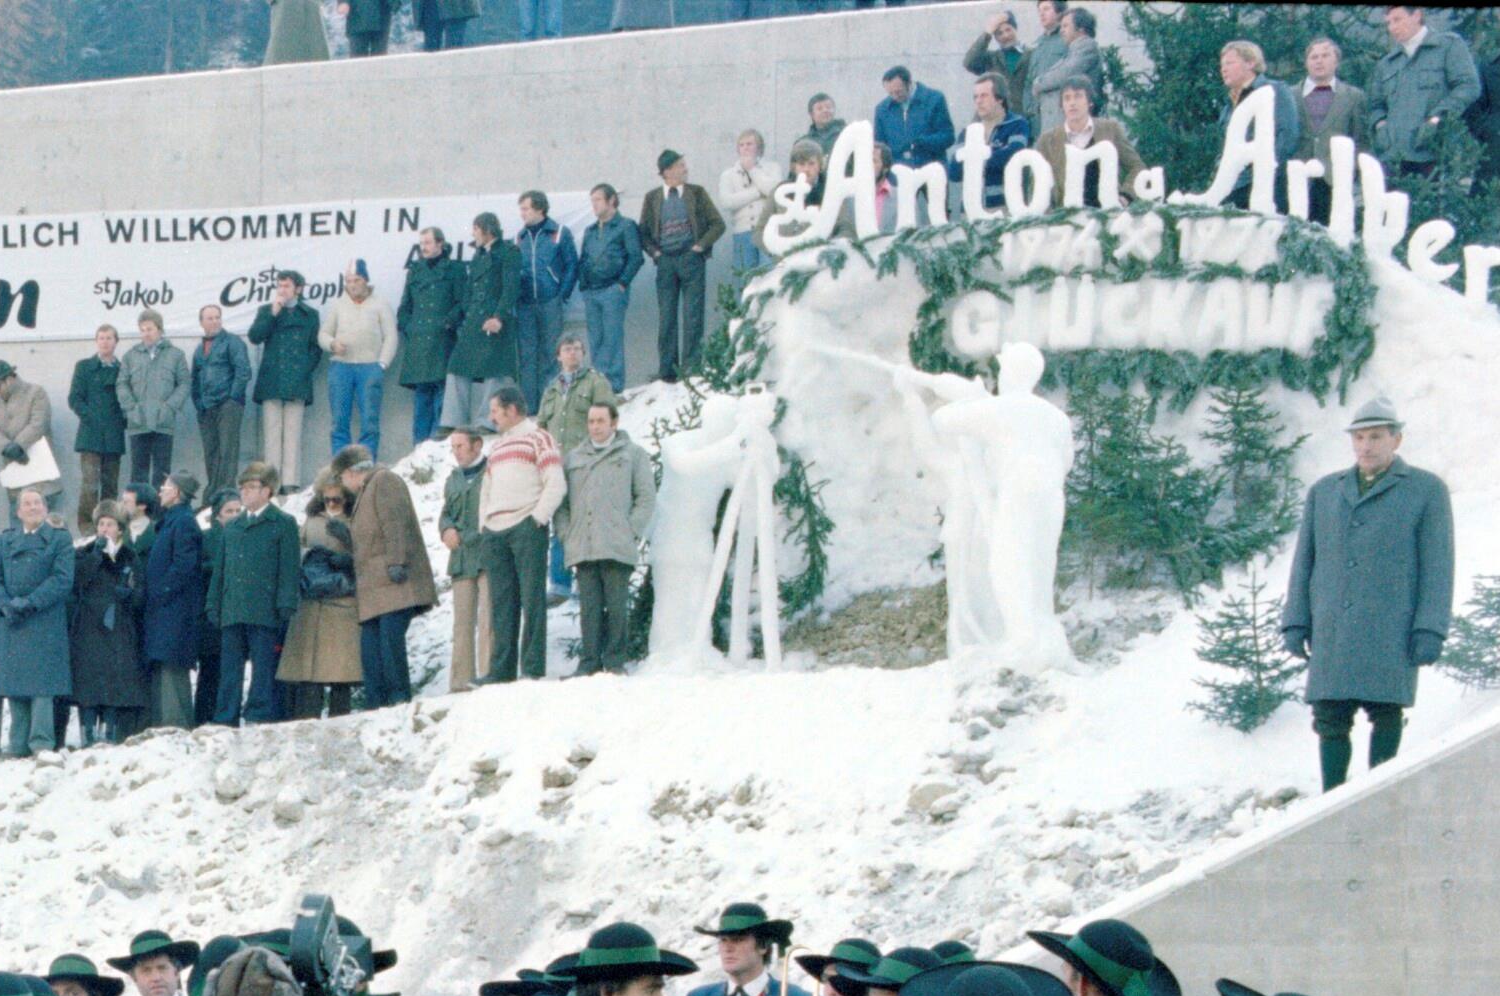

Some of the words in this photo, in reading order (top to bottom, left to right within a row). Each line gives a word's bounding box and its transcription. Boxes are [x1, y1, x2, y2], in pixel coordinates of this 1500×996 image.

[763, 119, 1121, 257] Anton
[105, 209, 356, 243] WILLKOMMEN
[382, 206, 421, 232] IN
[101, 279, 174, 310] Jakob
